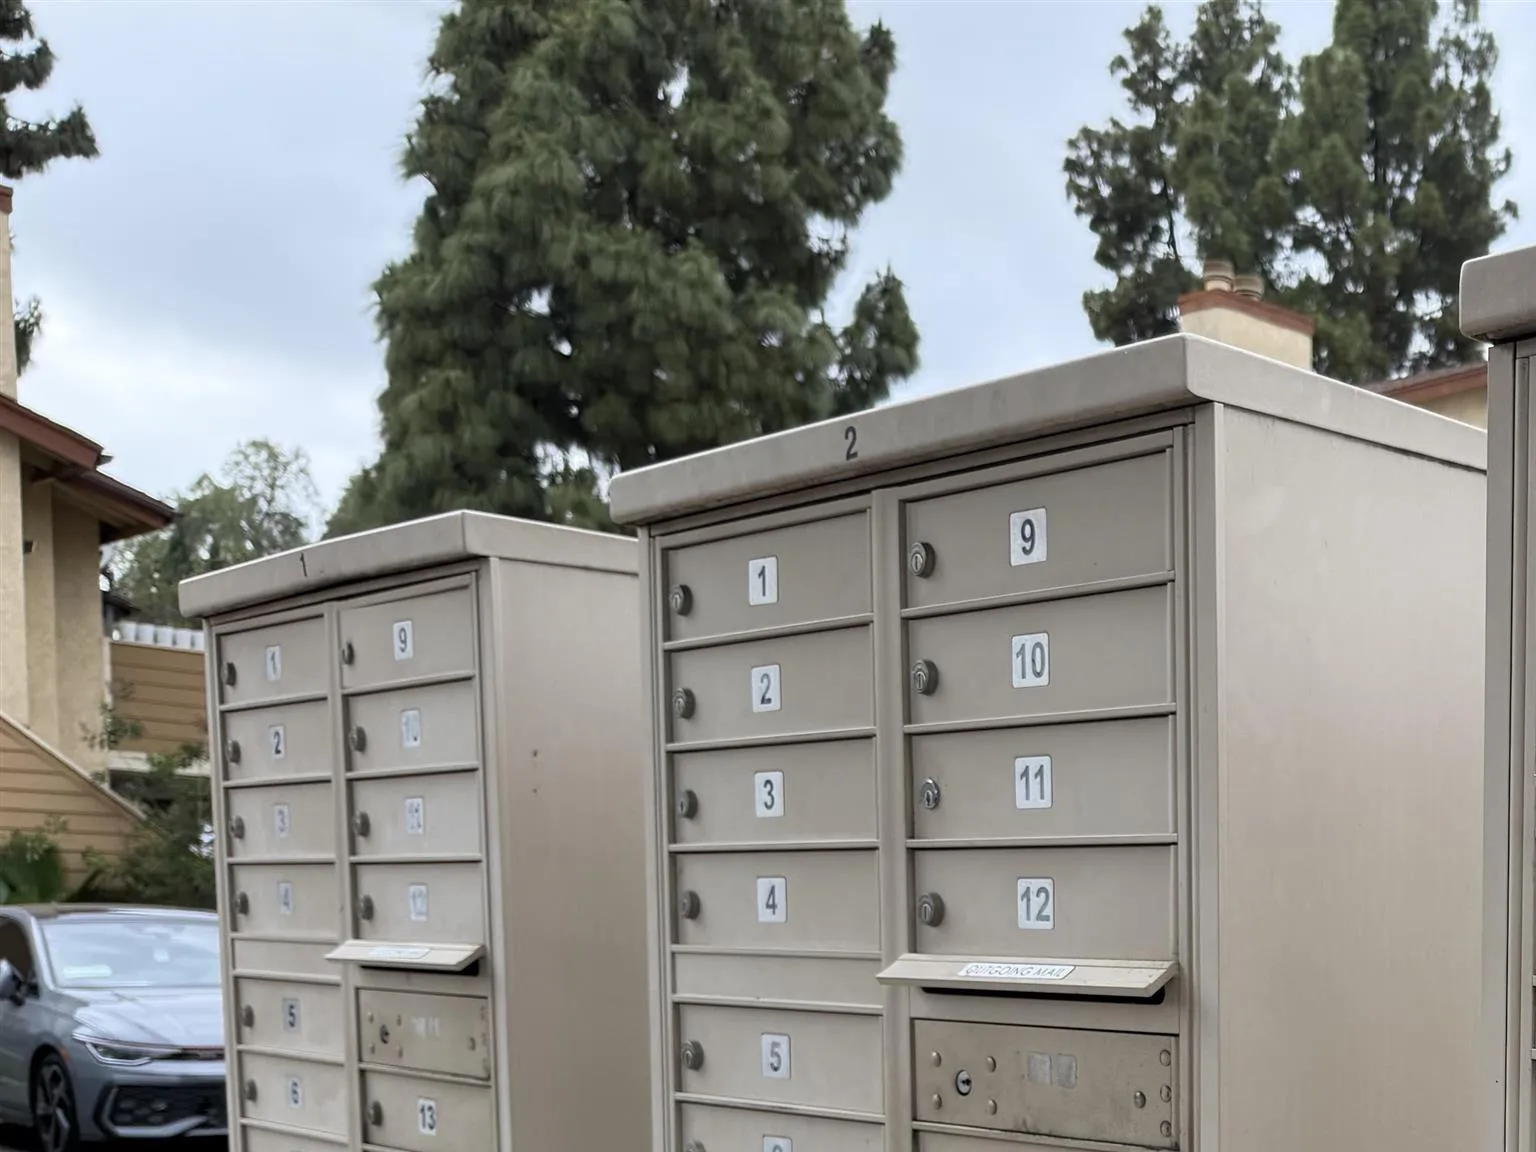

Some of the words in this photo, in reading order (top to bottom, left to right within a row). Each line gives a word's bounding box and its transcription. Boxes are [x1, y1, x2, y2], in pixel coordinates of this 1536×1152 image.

[843, 425, 859, 462] 2
[1020, 518, 1036, 556] 9
[757, 565, 766, 597] 1
[398, 627, 408, 653] 9
[270, 650, 277, 674] 1
[1015, 641, 1046, 680] 10
[760, 673, 773, 705] 2
[273, 731, 282, 755] 2
[763, 779, 775, 810] 3
[1019, 764, 1045, 801] 11
[765, 884, 778, 916] 4
[1020, 886, 1051, 922] 12
[966, 964, 1034, 976] OUTGOING
[1034, 967, 1065, 977] MAIL
[288, 1004, 296, 1028] 5
[769, 1040, 782, 1073] 5
[419, 1105, 436, 1130] 13
